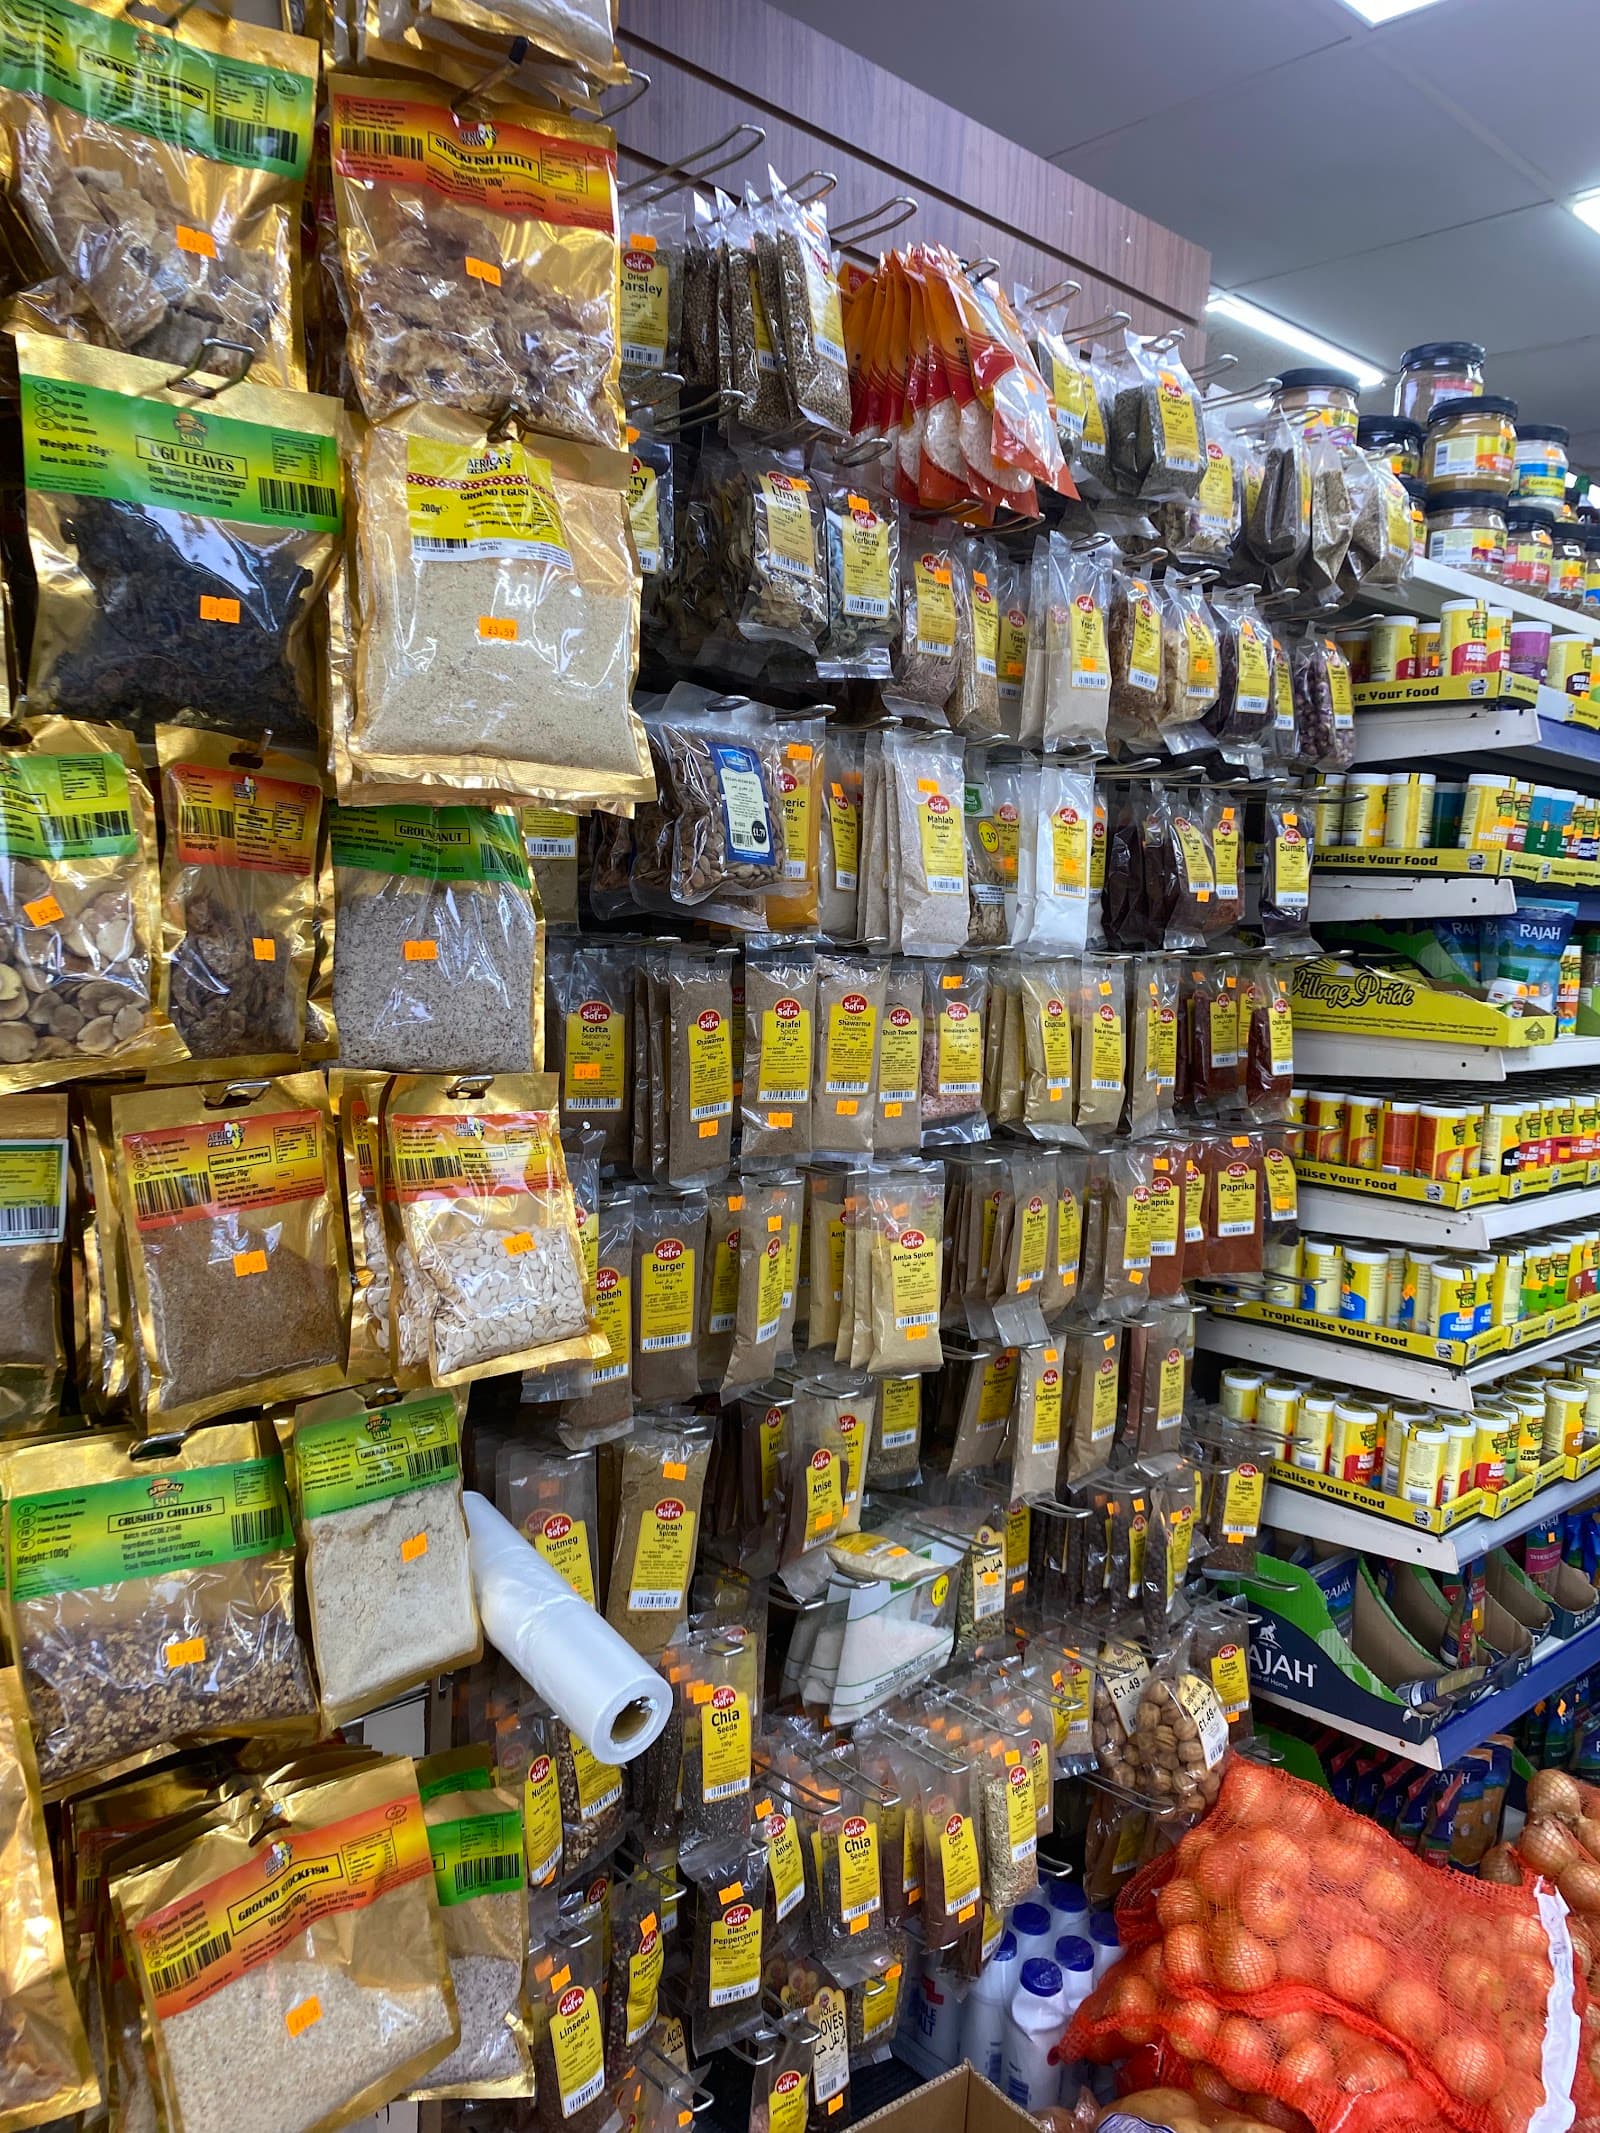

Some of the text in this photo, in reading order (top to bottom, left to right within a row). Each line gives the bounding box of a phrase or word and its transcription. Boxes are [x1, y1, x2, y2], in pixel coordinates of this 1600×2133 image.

[497, 154, 533, 172] FILLET
[626, 259, 652, 271] Sofra
[628, 273, 649, 282] Dried
[38, 438, 83, 452] Weight:
[184, 453, 235, 472] LEAVES
[467, 455, 512, 469] AFRICA'S
[460, 488, 529, 501] GROUND EGUSI
[772, 485, 801, 504] Lime
[420, 502, 441, 514] 200g
[854, 515, 875, 525] Sofra
[854, 528, 878, 538] Lemon
[852, 536, 879, 547] Verbena
[1369, 686, 1440, 701] Your Food
[929, 802, 948, 812] Sofra
[927, 816, 954, 824] Mahlab
[980, 831, 997, 842] 1.39
[1279, 844, 1305, 853] Sumac
[1313, 853, 1438, 867] picalise Your Food
[1519, 924, 1561, 940] RAJAH
[1350, 974, 1415, 1006] Pride
[777, 1008, 798, 1016] Sofra
[844, 1002, 864, 1011] Sofra
[583, 1012, 608, 1021] Sofra
[949, 1009, 966, 1017] Sofra
[700, 1021, 719, 1029] Sofra
[776, 1020, 801, 1028] Falafel
[838, 1019, 871, 1027] Shawarma
[582, 1025, 608, 1033] Kofta
[696, 1036, 725, 1047] Shawarma
[207, 1128, 244, 1143] AFRICA'S
[1220, 1183, 1255, 1192] Paprika
[1329, 1173, 1398, 1191] Your Food
[1151, 1199, 1174, 1207] aprika
[902, 1239, 923, 1248] Sofra
[657, 1249, 681, 1258] Sofra
[913, 1251, 934, 1260] Spices
[652, 1263, 685, 1272] Burger
[596, 1290, 622, 1300] ebbeh
[1261, 1307, 1408, 1347] Tropicalise Your Food
[886, 1385, 914, 1394] Coriander
[373, 1431, 391, 1439] SUN
[148, 1483, 183, 1496] AFRICAN
[812, 1480, 832, 1494] Anise
[1234, 1484, 1254, 1493] Powder
[1238, 1480, 1253, 1488] Lime
[155, 1496, 178, 1505] SUN
[1319, 1482, 1386, 1510] Your Food
[117, 1503, 213, 1527] CRUSHED CHILLIES
[657, 1508, 681, 1517] Sofra
[547, 1524, 569, 1536] Sofra
[656, 1523, 683, 1531] Kabsah
[546, 1537, 578, 1552] Nutmeg
[1324, 1576, 1352, 1601] RAJAH
[1219, 1666, 1239, 1676] Powder
[1221, 1662, 1237, 1670] Lime
[1113, 1677, 1140, 1698] £1.49
[713, 1697, 735, 1708] Sofra
[711, 1710, 740, 1726] Chia
[1199, 1709, 1214, 1732] £1.49
[717, 1723, 738, 1734] Seeds
[532, 1767, 549, 1782] Sofra
[1012, 1774, 1027, 1784] Sofra
[532, 1777, 554, 1799] Nutmeg
[1012, 1781, 1032, 1795] Fennel
[844, 1825, 865, 1834] Sofra
[948, 1820, 963, 1831] Sofra
[773, 1834, 788, 1846] Star
[948, 1832, 964, 1845] Cress
[775, 1840, 793, 1857] Anise
[844, 1838, 871, 1853] Chia
[850, 1850, 870, 1859] Seeds
[237, 1864, 329, 1922] GROUND STOCKFISH
[726, 1913, 749, 1925] Sofra
[727, 1925, 748, 1935] Black
[713, 1929, 759, 1944] Peppercorns
[641, 1938, 656, 1954] Sofra
[561, 1996, 584, 2015] Sofra
[560, 2011, 591, 2039] Linseed
[667, 2024, 682, 2043] ACID
[778, 2077, 798, 2093] Sofra
